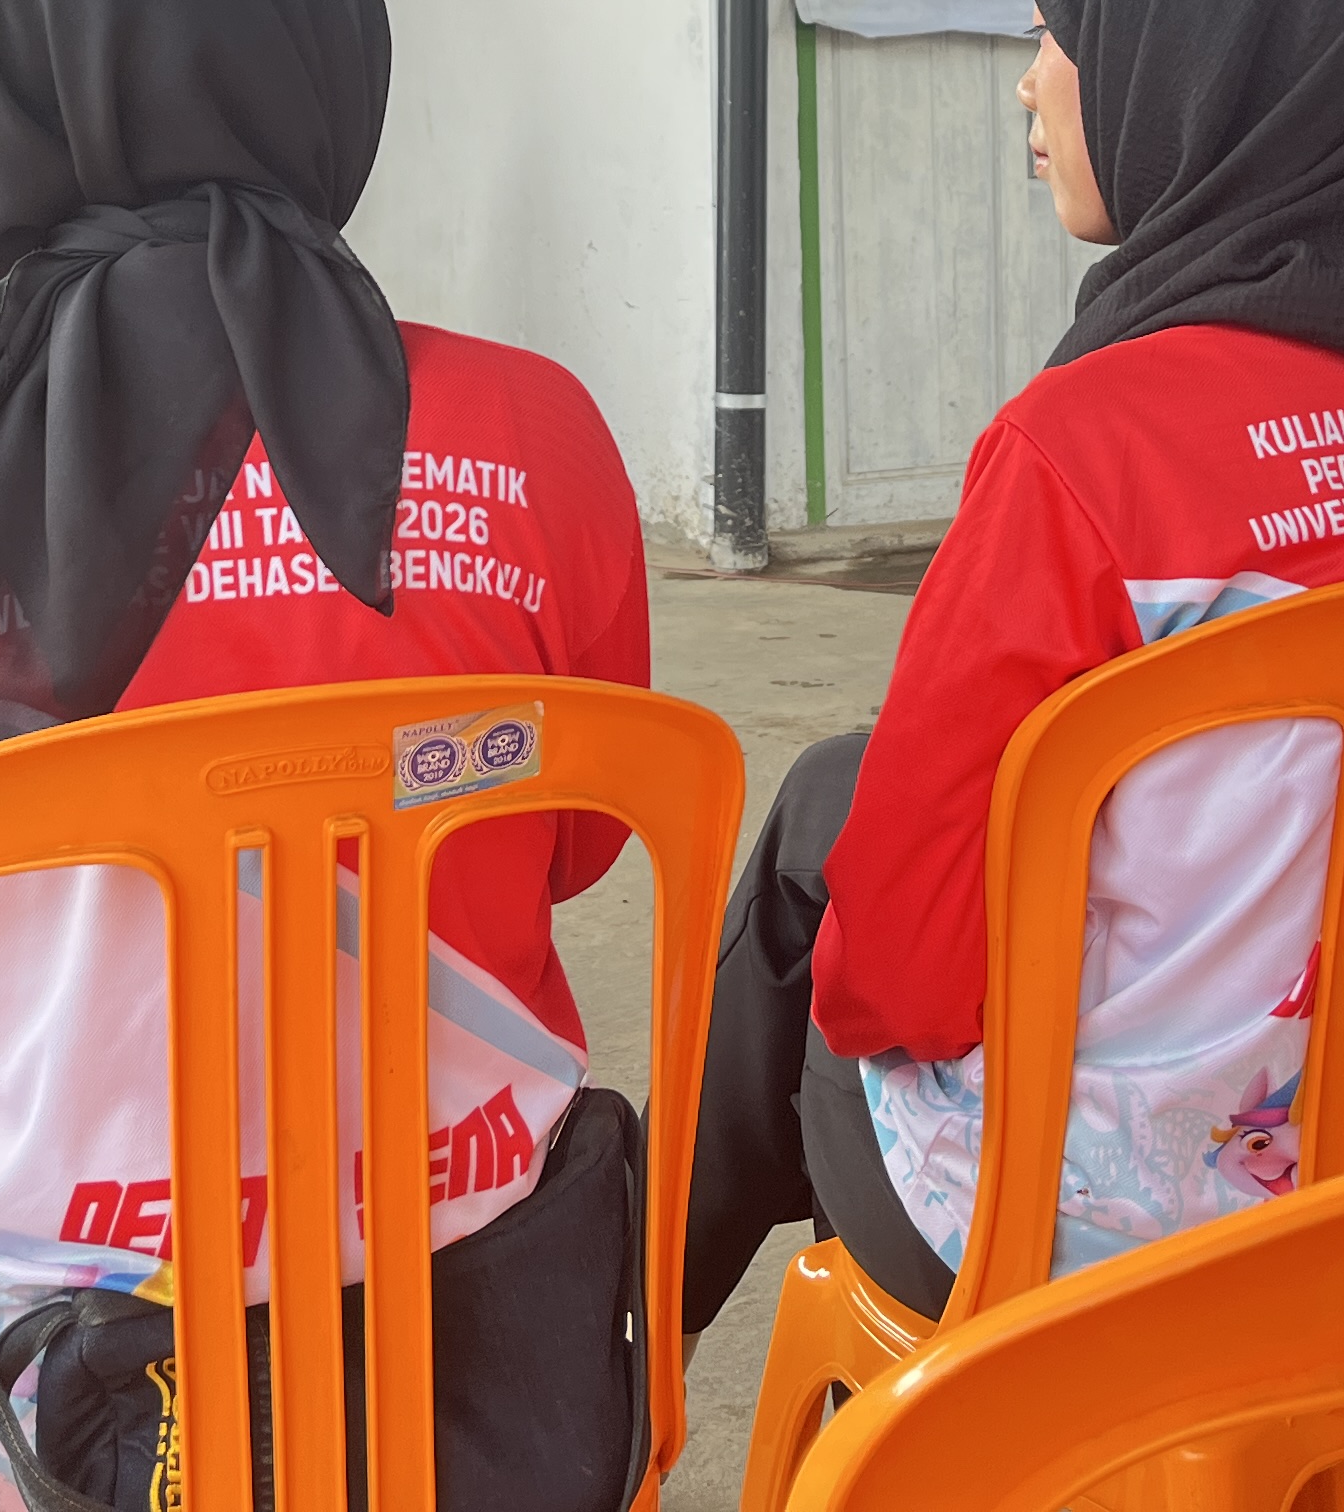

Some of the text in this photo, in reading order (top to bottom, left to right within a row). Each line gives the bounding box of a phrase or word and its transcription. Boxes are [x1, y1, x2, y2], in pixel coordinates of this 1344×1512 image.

[401, 451, 528, 509] EMATIK
[396, 498, 489, 545] 2026
[185, 553, 344, 603] DEHASE
[381, 549, 546, 613] BENGKUU
[401, 723, 453, 739] NAPOLLY
[220, 754, 345, 788] NAPOLLY
